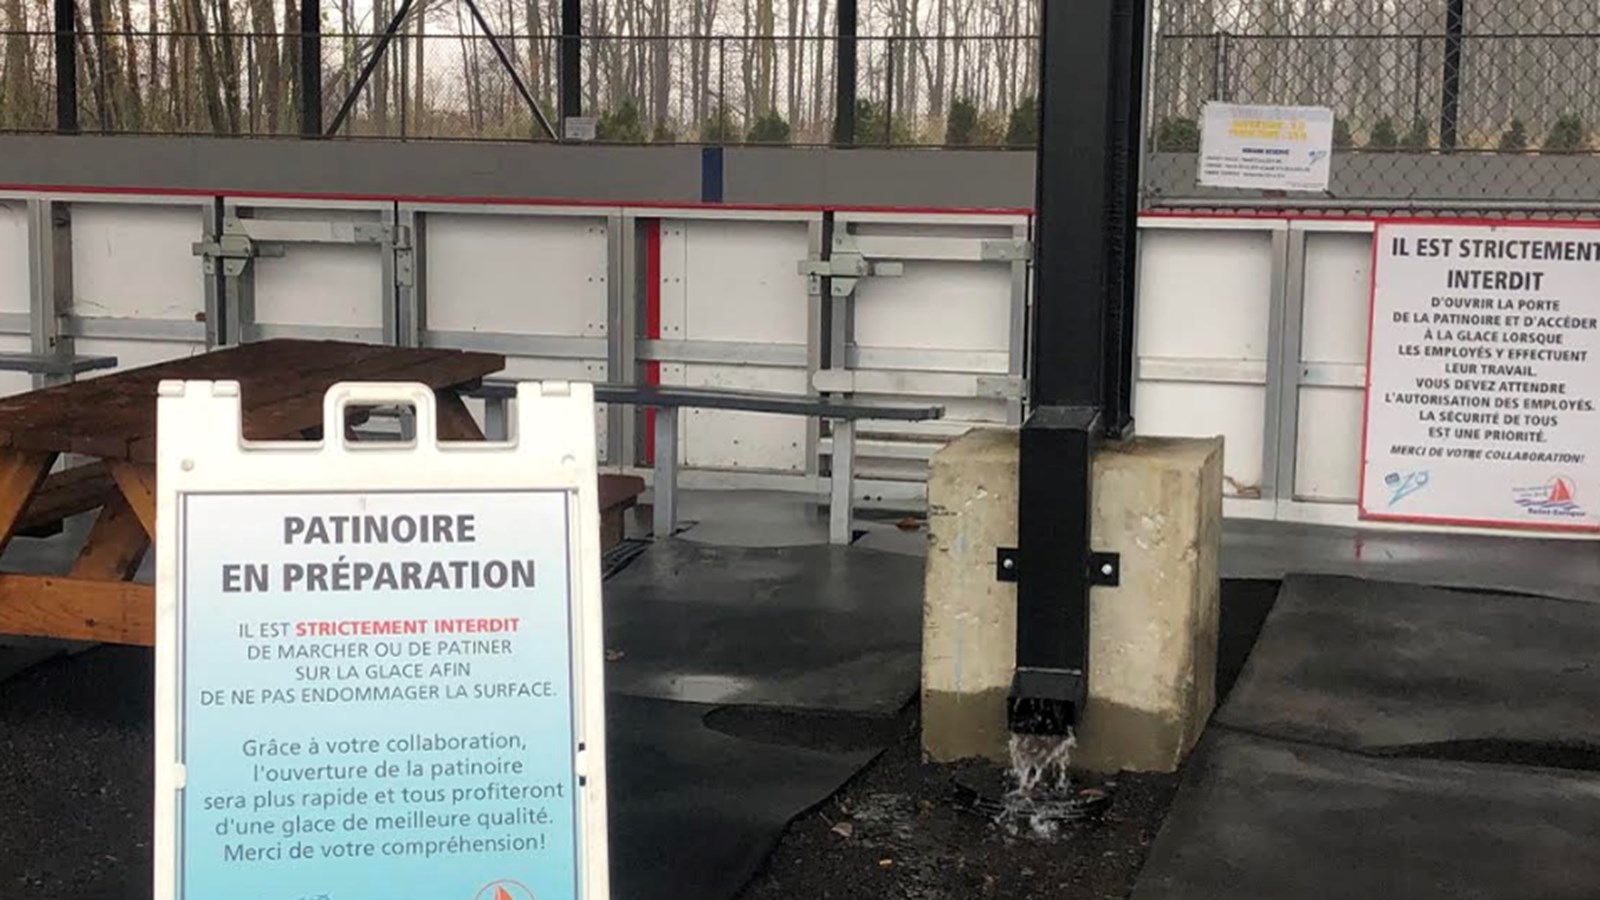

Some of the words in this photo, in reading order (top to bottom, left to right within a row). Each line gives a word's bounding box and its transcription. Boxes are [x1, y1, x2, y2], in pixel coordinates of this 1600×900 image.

[1393, 238, 1409, 256] IL
[1417, 239, 1453, 257] EST
[1460, 239, 1600, 261] STRICTEMENT
[1448, 270, 1544, 290] INTERDIT
[1431, 297, 1493, 309] D'OUVRIR
[1498, 299, 1513, 309] LA
[1518, 300, 1559, 311] PORTE
[1393, 312, 1409, 322] DE
[1414, 313, 1429, 323] LA
[1434, 313, 1500, 326] PATINOIRE
[1505, 316, 1520, 326] ET
[1524, 316, 1597, 329] D'ACCÉDER
[1424, 328, 1433, 340] À
[1437, 330, 1453, 340] LA
[1457, 330, 1498, 342] GLACE
[1503, 332, 1562, 345] LORSQUE
[1399, 345, 1420, 356] LES
[1425, 346, 1492, 358] EMPLOYÉS
[1496, 349, 1504, 358] Y
[1508, 349, 1587, 361] EFFECTUENT
[1445, 363, 1477, 374] LEUR
[1481, 364, 1536, 376] TRAVAIL.
[1416, 378, 1450, 389] VOUS
[1455, 380, 1496, 391] DEVEZ
[1499, 382, 1565, 394] ATTENDRE
[1385, 393, 1490, 407] L'AUTORISATION
[1495, 398, 1519, 409] DES
[1524, 399, 1595, 411] EMPLOYÉS.
[1420, 410, 1435, 420] LA
[1439, 411, 1501, 424] SÉCURITÉ
[1504, 414, 1520, 425] DE
[1525, 415, 1557, 426] TOUS
[1429, 427, 1450, 437] EST
[1455, 429, 1480, 439] UNE
[1485, 430, 1546, 442] PRIORITÉ.
[1390, 445, 1426, 456] MERCI
[1429, 447, 1443, 457] DE
[1447, 449, 1482, 459] VOTRE
[1485, 450, 1585, 463] COLLABORATION!
[284, 515, 475, 544] PATINOIRE
[223, 564, 268, 592] EN
[284, 555, 535, 591] PRÉPARATION
[240, 624, 254, 638] IL
[260, 622, 290, 638] EST
[296, 620, 427, 636] STRICTEMENT
[435, 618, 519, 633] INTERDIT
[248, 645, 271, 660] DE
[278, 643, 368, 659] MARCHER
[375, 642, 401, 657] OU
[409, 641, 431, 656] DE
[438, 640, 512, 655] PATINER
[296, 666, 330, 681] SUR
[337, 665, 359, 680] LA
[365, 664, 422, 679] GLACE
[429, 663, 470, 677] AFIN
[201, 690, 224, 705] DE
[232, 690, 254, 704] NE
[262, 688, 295, 704] PAS
[302, 685, 439, 703] ENDOMMAGER
[446, 685, 468, 699] LA
[474, 682, 557, 698] SURFACE.
[243, 739, 301, 757] Grâce
[309, 738, 319, 755] à
[326, 738, 380, 754] votre
[387, 732, 526, 752] collaboration,
[254, 764, 367, 782] l'ouverture
[375, 760, 399, 778] de
[407, 760, 423, 777] la
[431, 758, 523, 779] patinoire
[204, 793, 246, 810] sera
[254, 790, 295, 812] plus
[302, 787, 368, 811] rapide
[375, 789, 395, 804] et
[401, 788, 445, 803] tous
[453, 782, 564, 807] profiteront
[216, 817, 275, 835] d'une
[282, 815, 335, 838] glace
[343, 813, 368, 831] de
[376, 811, 470, 829] meilleure
[477, 807, 553, 830] qualité.
[224, 842, 281, 861] Merci
[289, 841, 314, 859] de
[321, 842, 375, 858] votre
[382, 833, 544, 858] compréhension!
